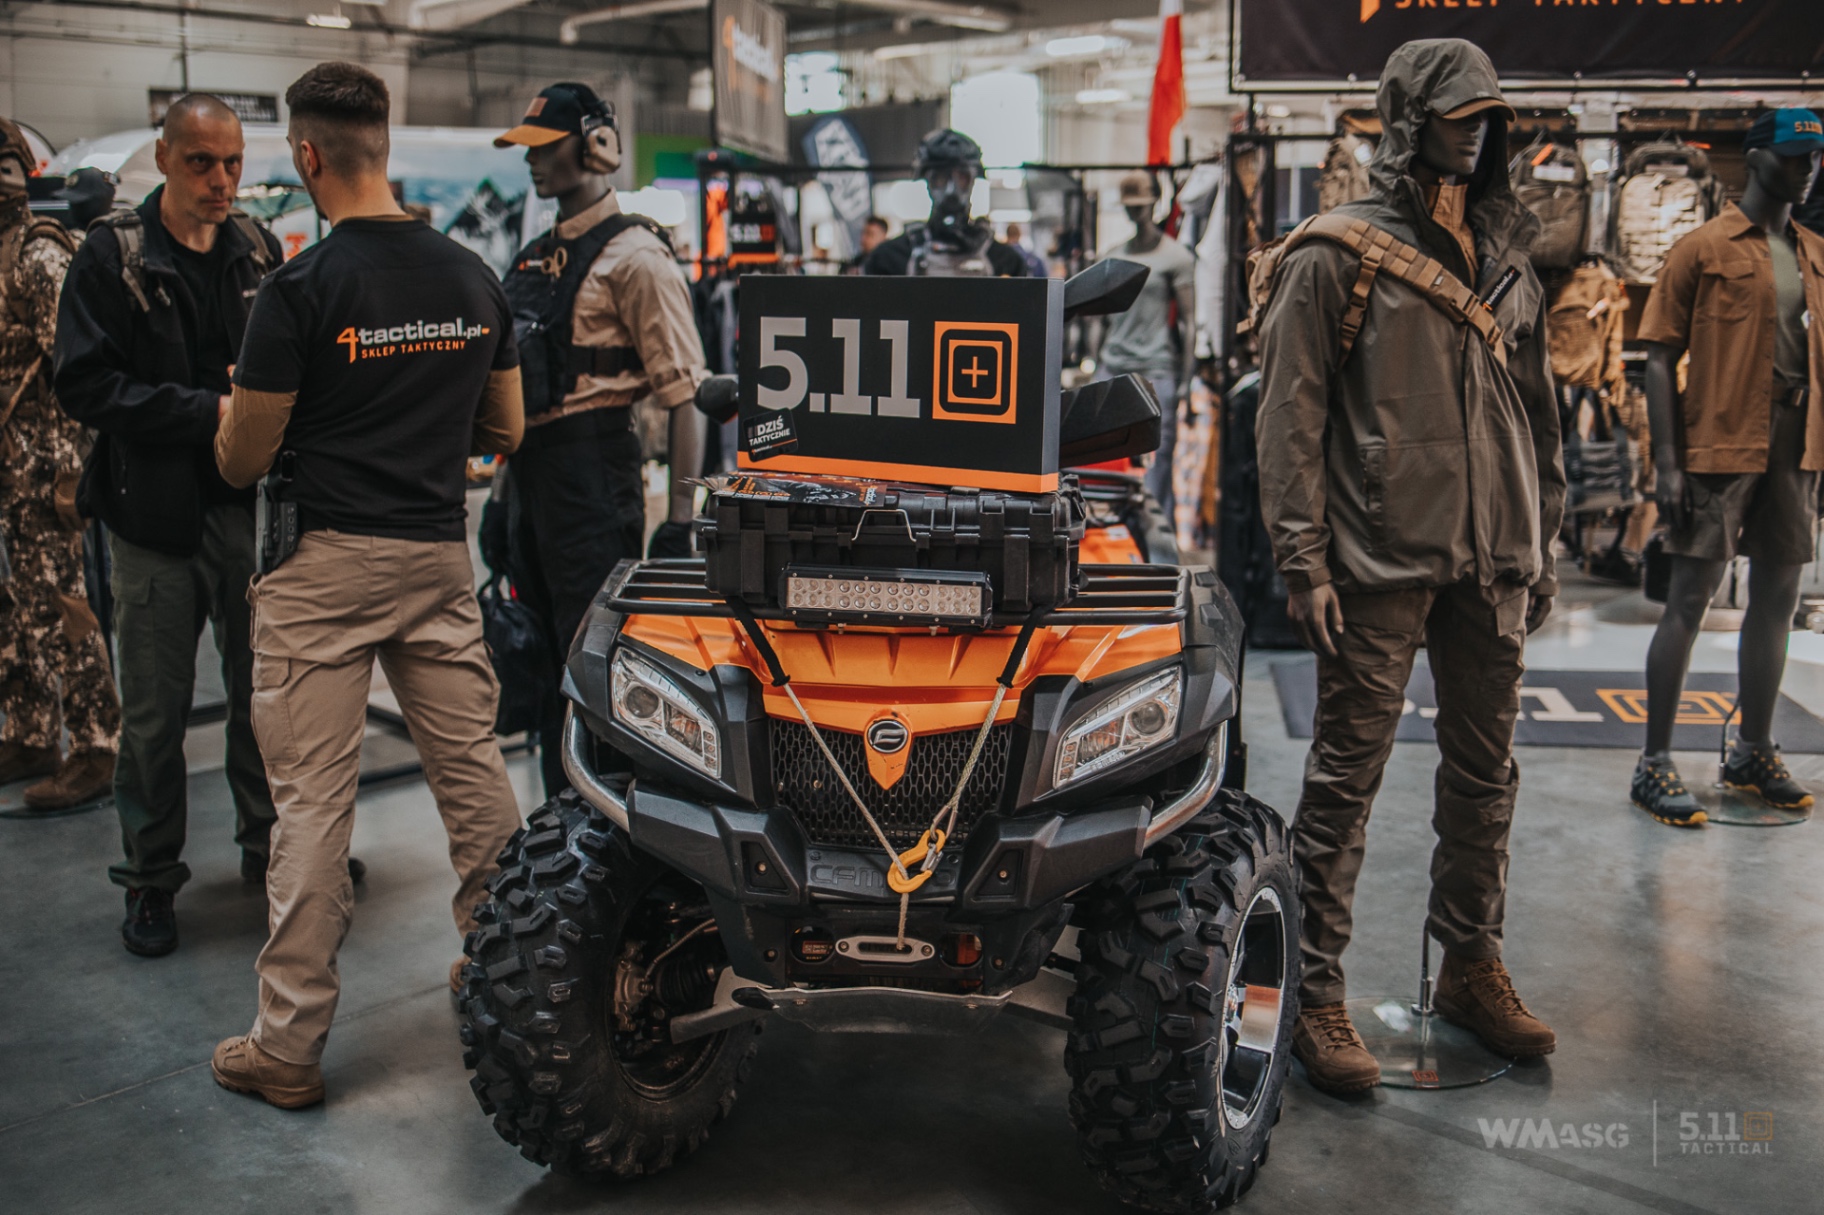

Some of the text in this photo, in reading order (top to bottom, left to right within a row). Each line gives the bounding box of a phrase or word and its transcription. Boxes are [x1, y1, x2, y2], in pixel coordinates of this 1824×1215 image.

[361, 340, 466, 359] SKLEP TAKTYCZNY
[757, 316, 921, 418] 5.11
[757, 415, 784, 436] DZIŚ
[749, 428, 790, 446] TAKTYCZNIE
[810, 864, 957, 887] CFMO
